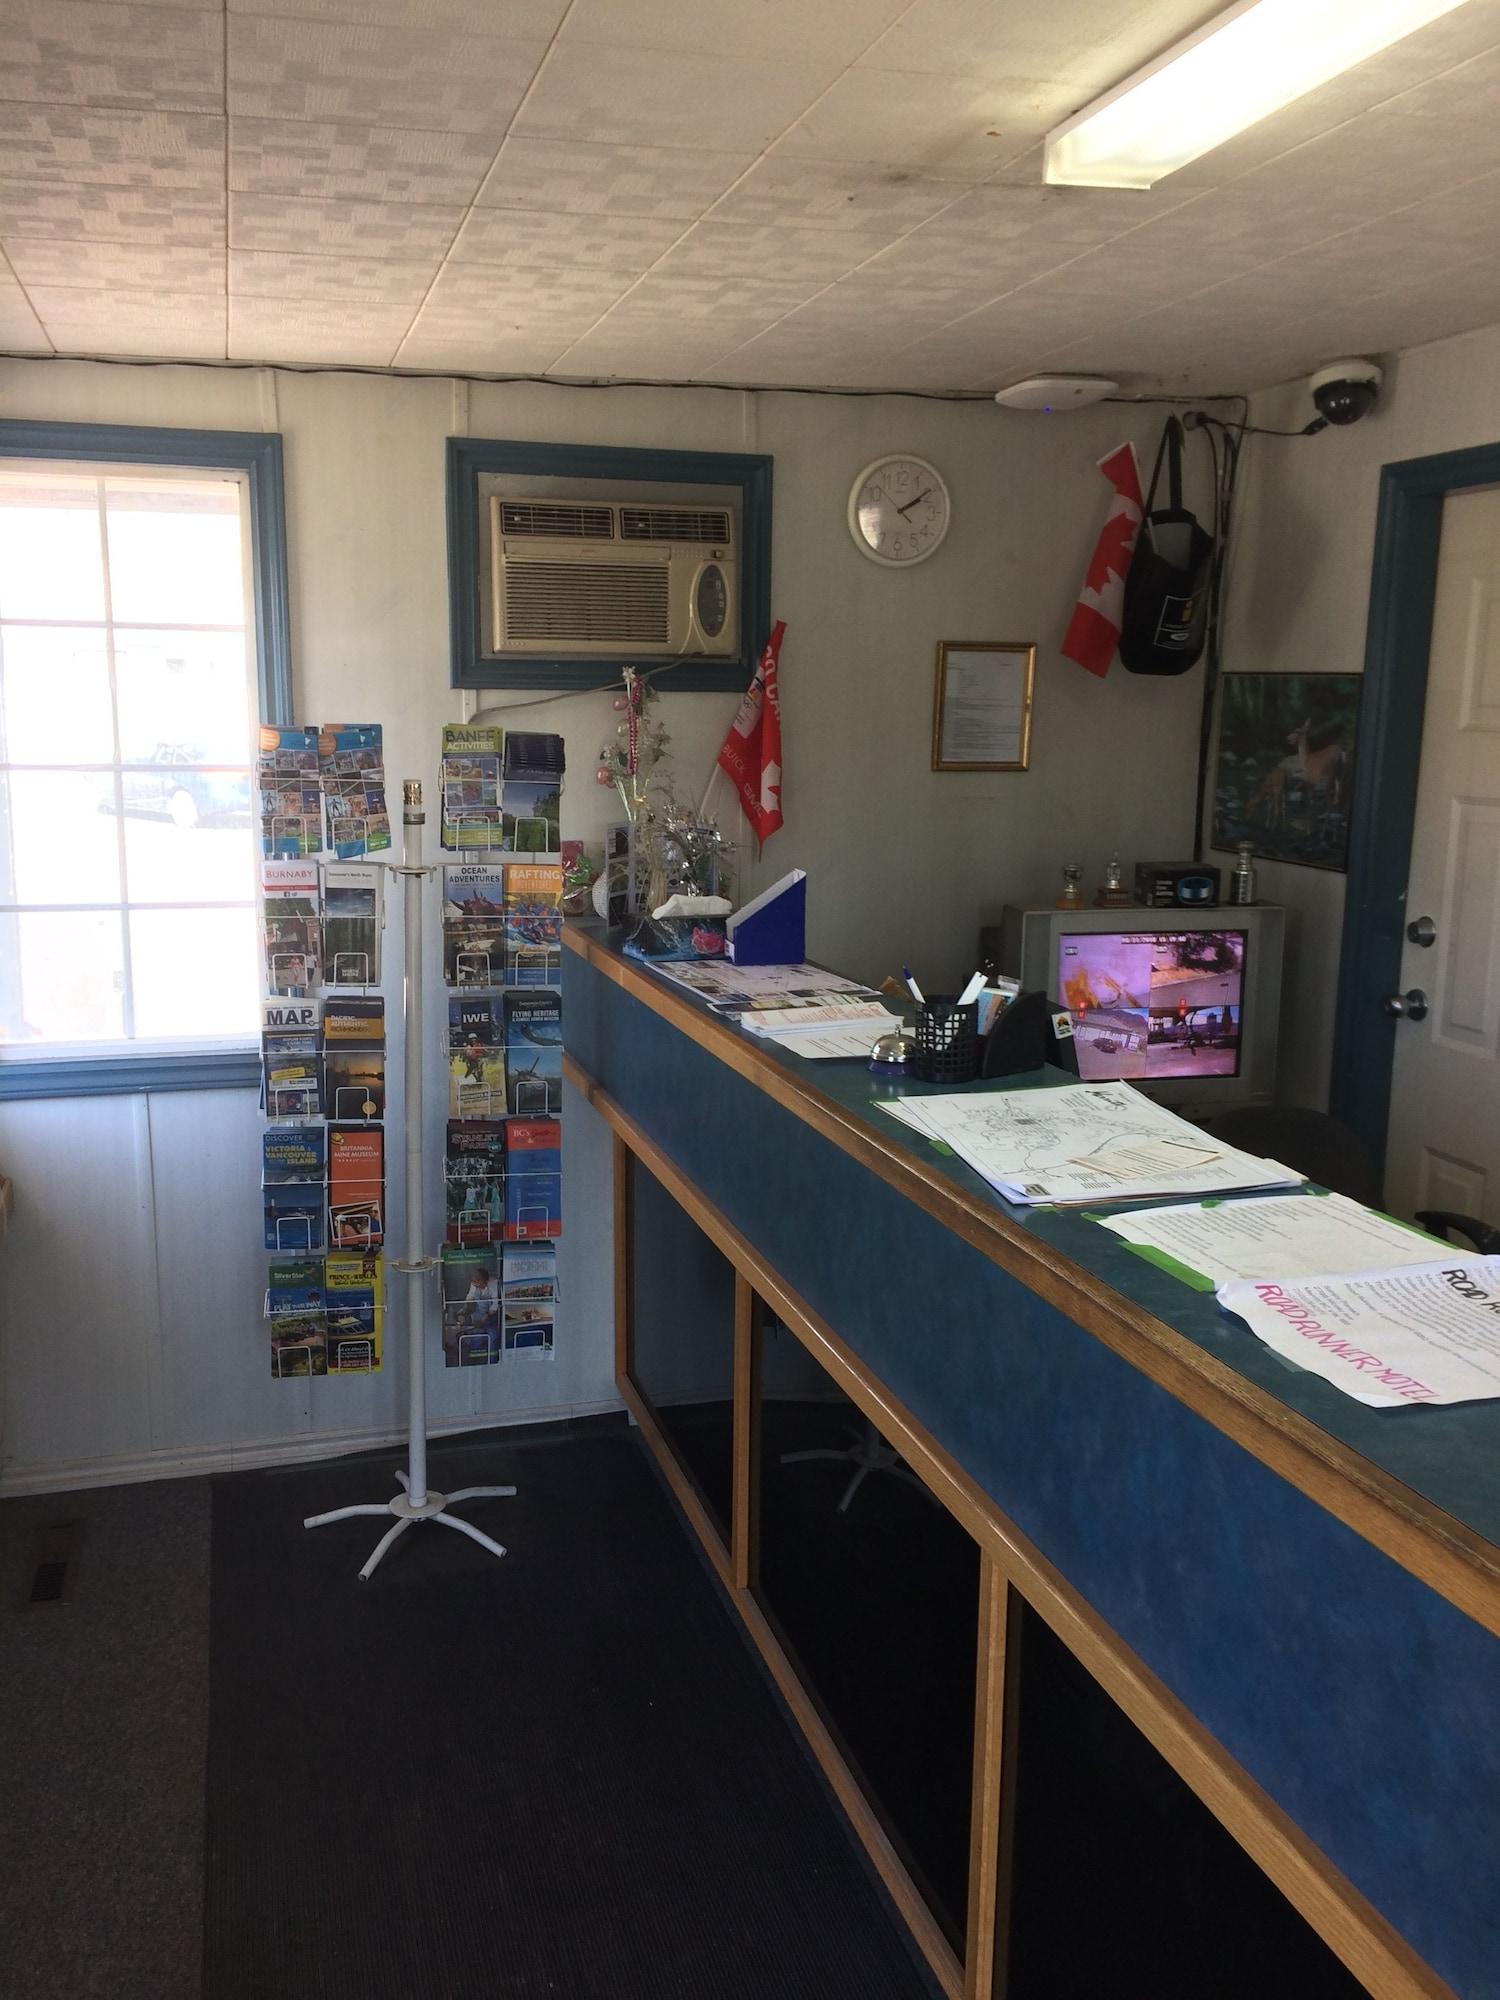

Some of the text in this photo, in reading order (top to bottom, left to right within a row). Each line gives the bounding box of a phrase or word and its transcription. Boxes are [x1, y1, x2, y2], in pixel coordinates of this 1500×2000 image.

[447, 741, 495, 750] ACTIVITIES
[723, 745, 746, 772] BUICK
[743, 783, 764, 817] GMC
[266, 870, 313, 879] BURNABY
[449, 875, 500, 883] ADVENTURES
[510, 869, 560, 880] RAFTING
[266, 1009, 313, 1025] MAP
[462, 1013, 489, 1023] IWE
[1441, 1269, 1489, 1300] ROAD
[1374, 1368, 1441, 1402] MOTEL
